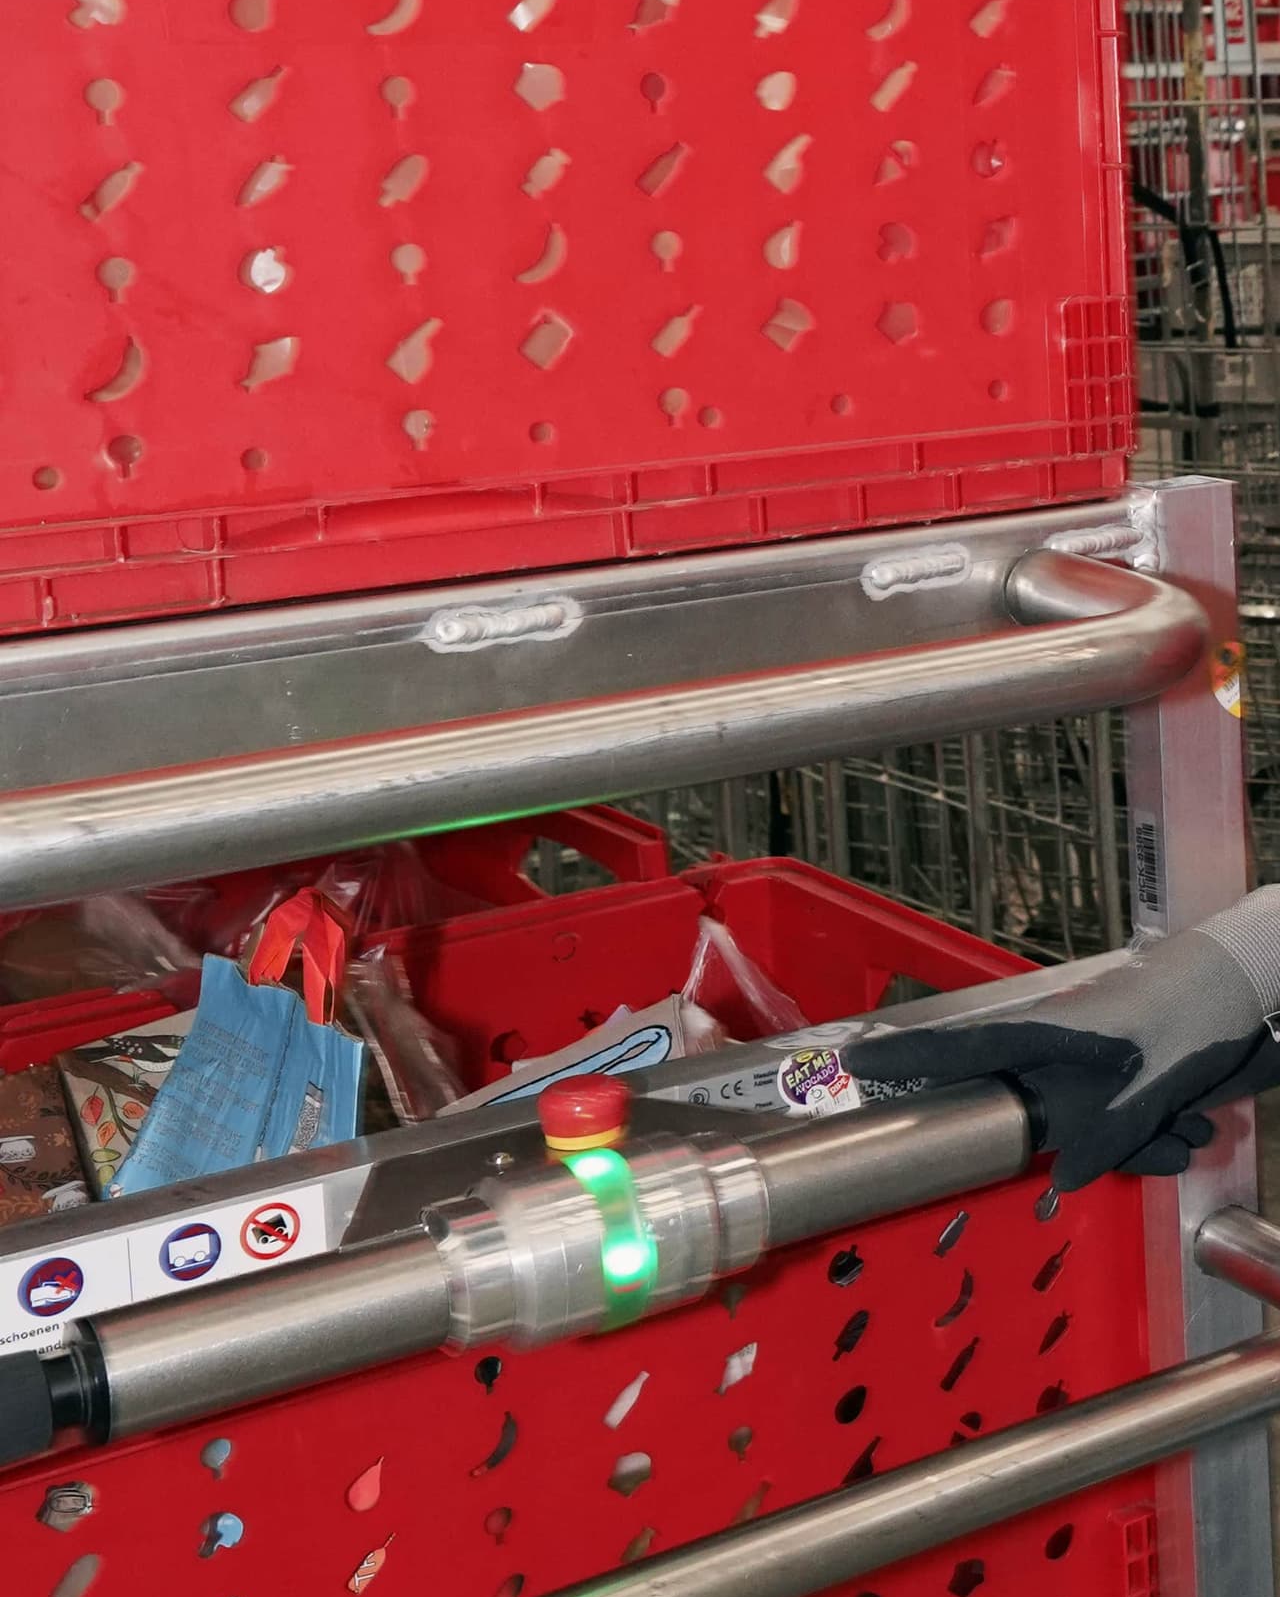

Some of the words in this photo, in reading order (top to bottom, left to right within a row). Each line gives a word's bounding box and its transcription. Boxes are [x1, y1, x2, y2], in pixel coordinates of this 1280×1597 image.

[785, 1063, 811, 1089] EAT
[812, 1050, 832, 1070] ME
[795, 1064, 835, 1096] AVOCADO
[0, 1323, 60, 1345] schoenen
